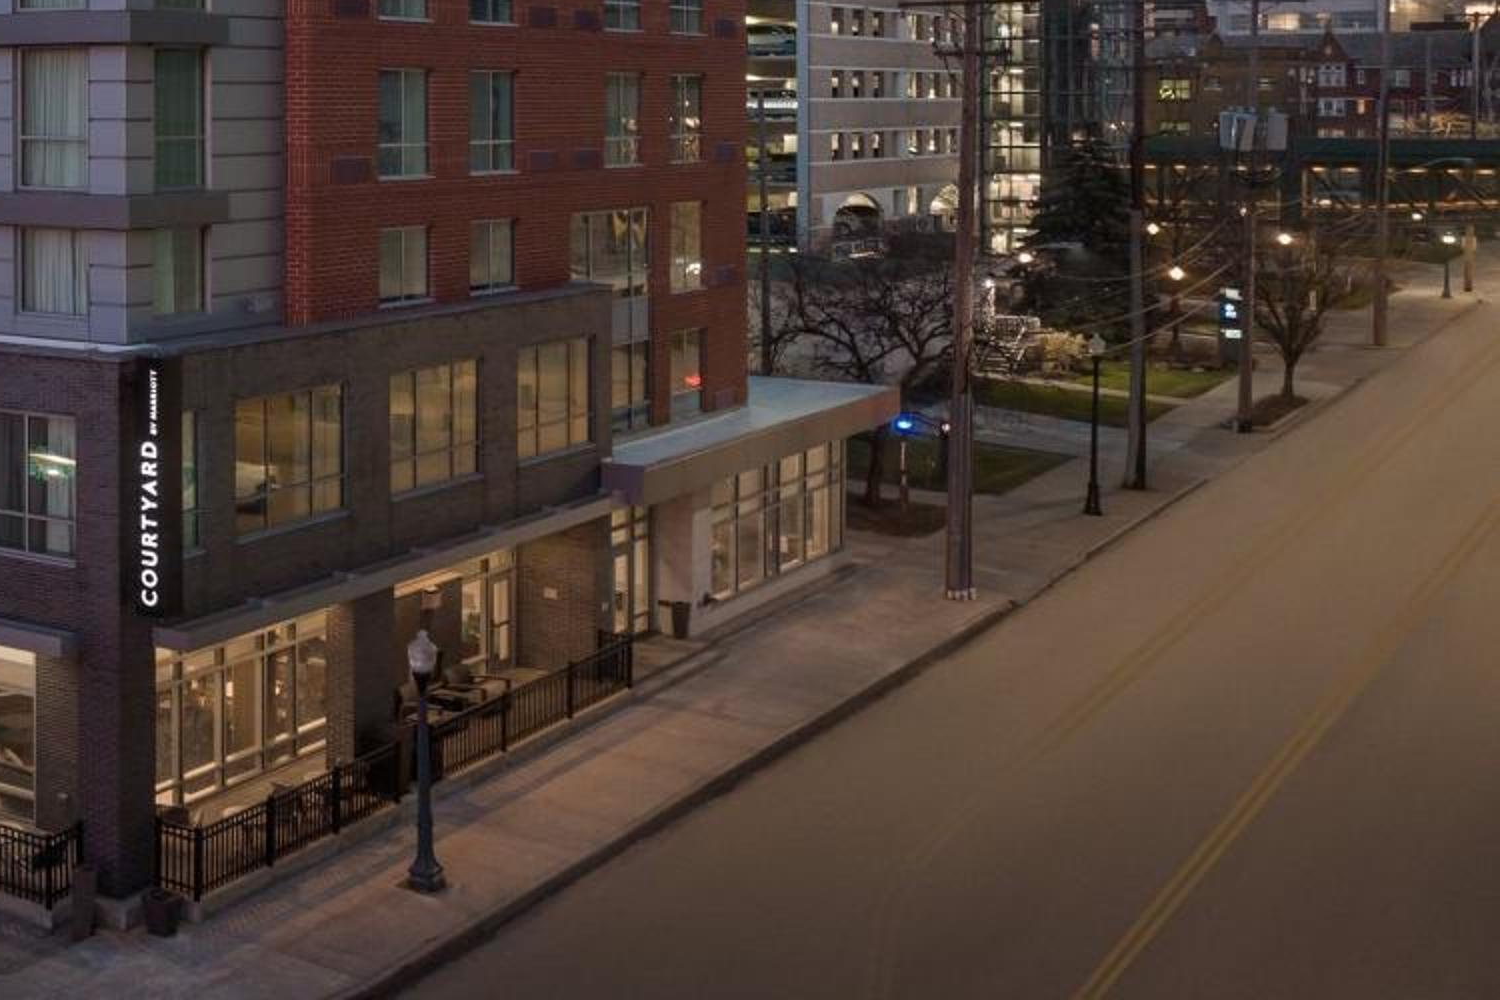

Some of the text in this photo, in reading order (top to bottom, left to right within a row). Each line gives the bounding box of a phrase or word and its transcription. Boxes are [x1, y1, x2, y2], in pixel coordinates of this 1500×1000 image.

[141, 369, 159, 607] COURTYARD BY MARRIOTT
